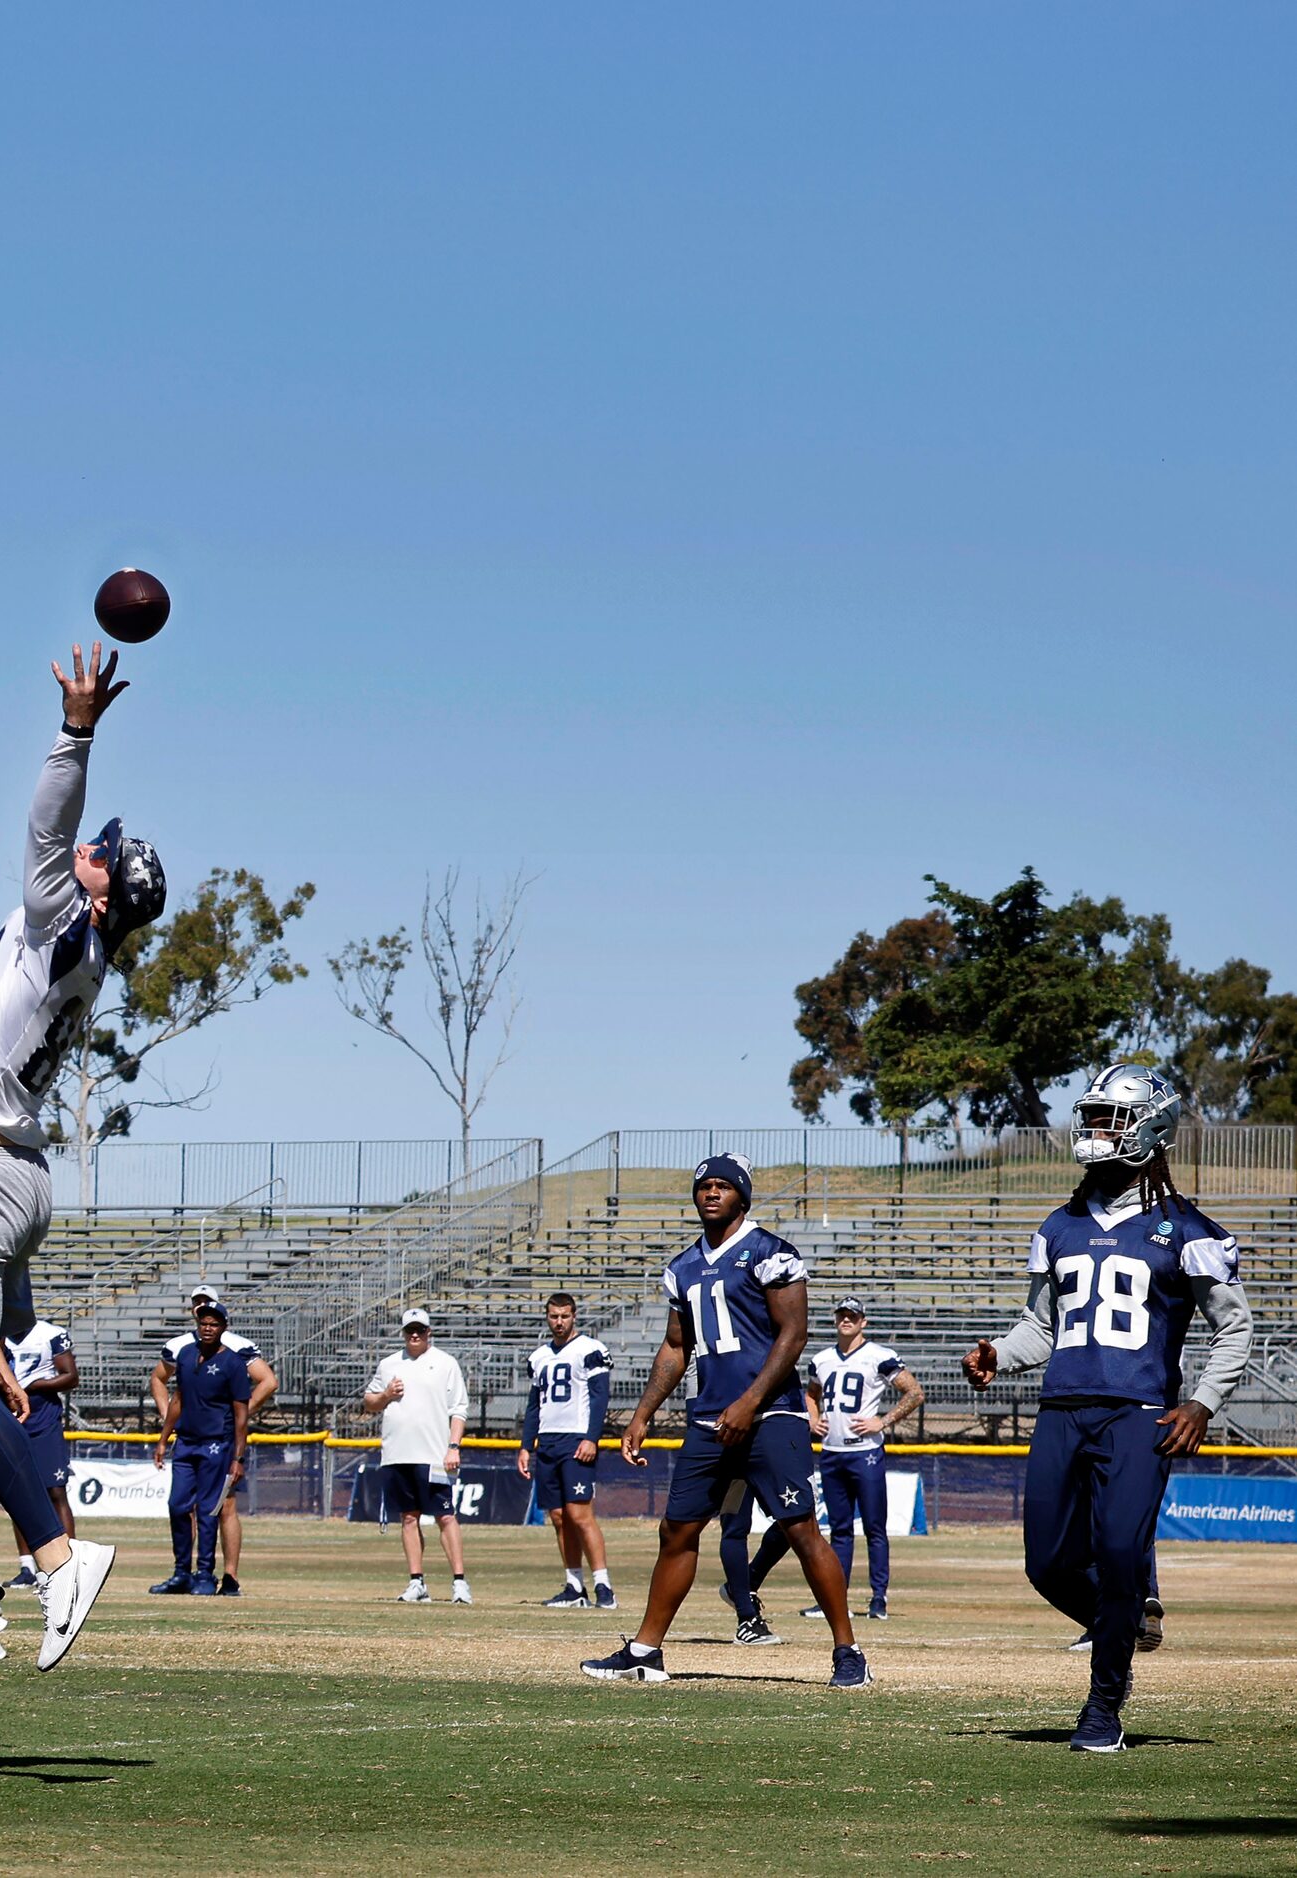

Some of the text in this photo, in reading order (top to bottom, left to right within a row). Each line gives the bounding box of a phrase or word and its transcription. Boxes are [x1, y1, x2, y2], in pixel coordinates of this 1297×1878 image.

[1149, 1232, 1172, 1247] AT&T
[686, 1279, 742, 1358] 11
[1054, 1253, 1152, 1351] 28
[539, 1362, 572, 1404] 48
[822, 1371, 864, 1414] 49
[1166, 1502, 1295, 1523] American Airlines
